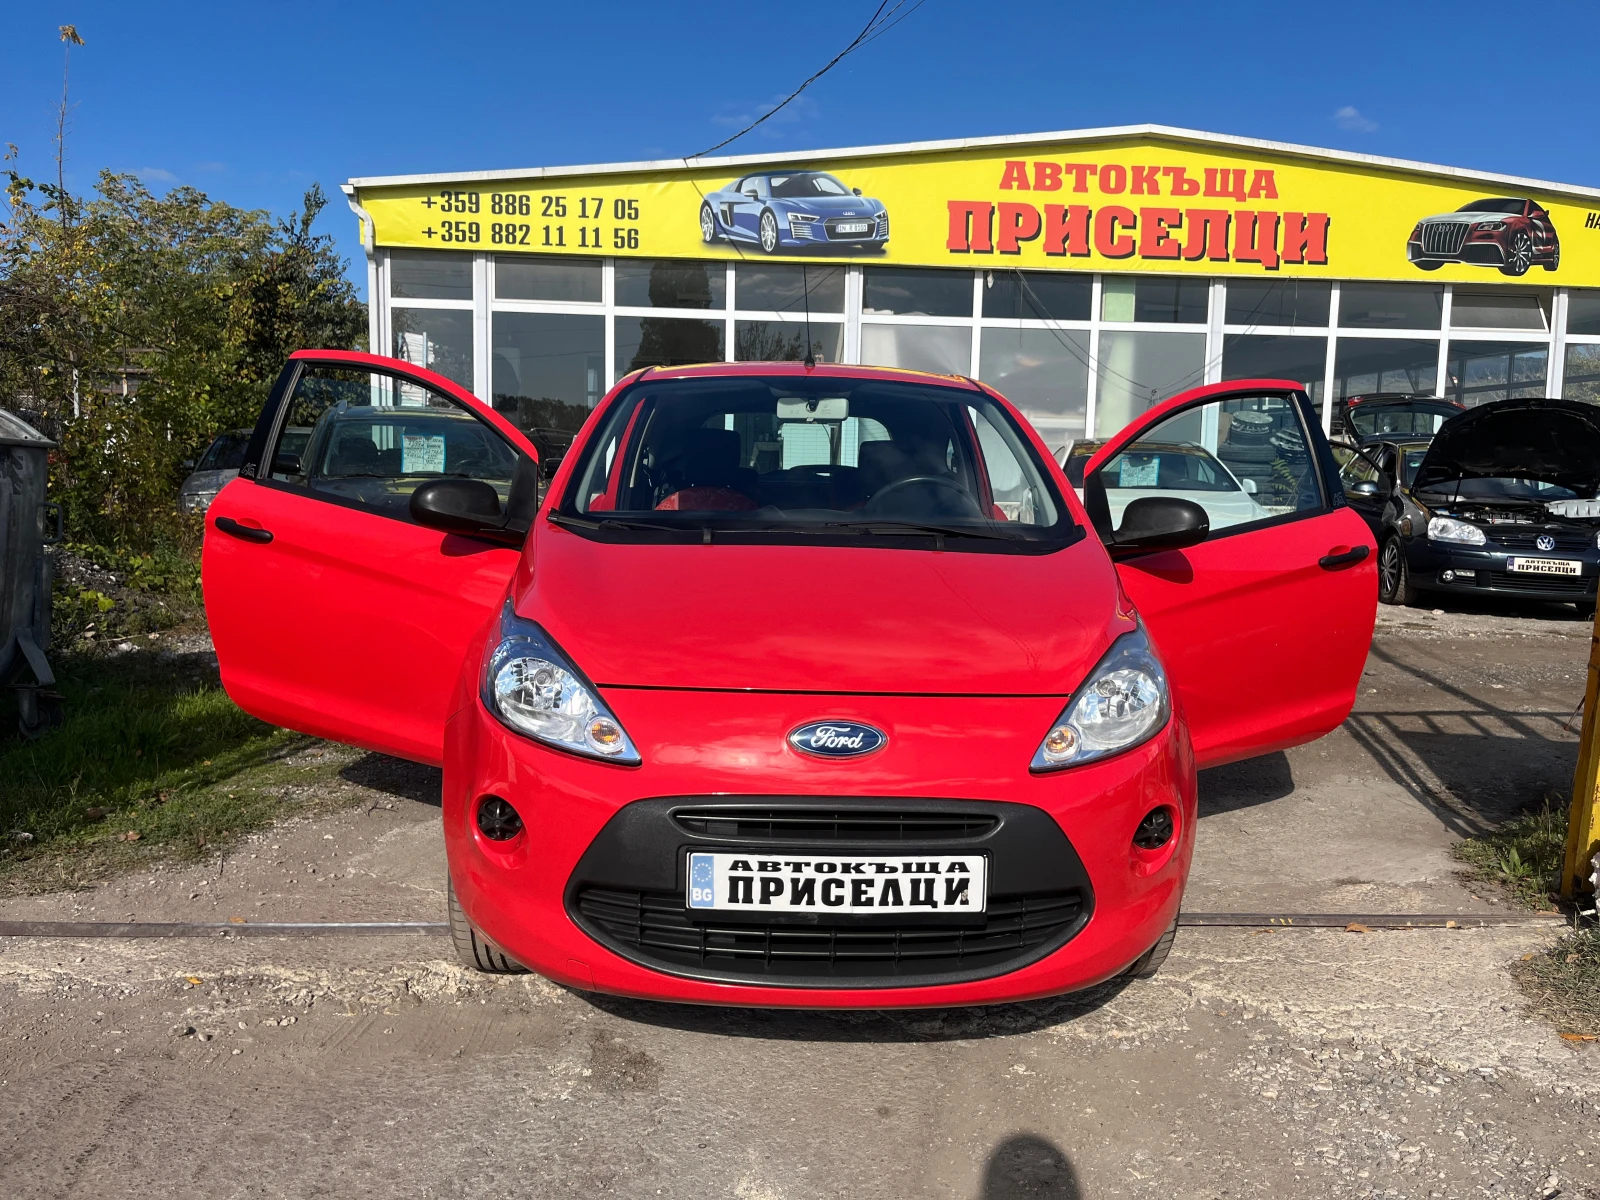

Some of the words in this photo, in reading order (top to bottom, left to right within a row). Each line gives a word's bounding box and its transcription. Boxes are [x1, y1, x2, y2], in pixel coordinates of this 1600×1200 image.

[999, 160, 1279, 203] АВТОКЪЩА
[421, 190, 480, 214] +359
[491, 193, 530, 216] 886
[541, 195, 567, 218] 25
[578, 197, 604, 219] 17
[613, 198, 640, 221] 05
[421, 220, 480, 243] +359
[491, 222, 530, 246] 882
[541, 224, 567, 247] 11
[577, 226, 603, 248] 11
[613, 227, 639, 250] 56
[946, 200, 1331, 271] ПРИСЕЛЦИ
[1518, 564, 1576, 574] ПРИСЕЛЦИ
[811, 725, 863, 748] Ford
[728, 859, 971, 875] АВТОКЪЩА
[691, 887, 713, 902] BG
[727, 875, 971, 909] ПРИСЕЛЦИ
